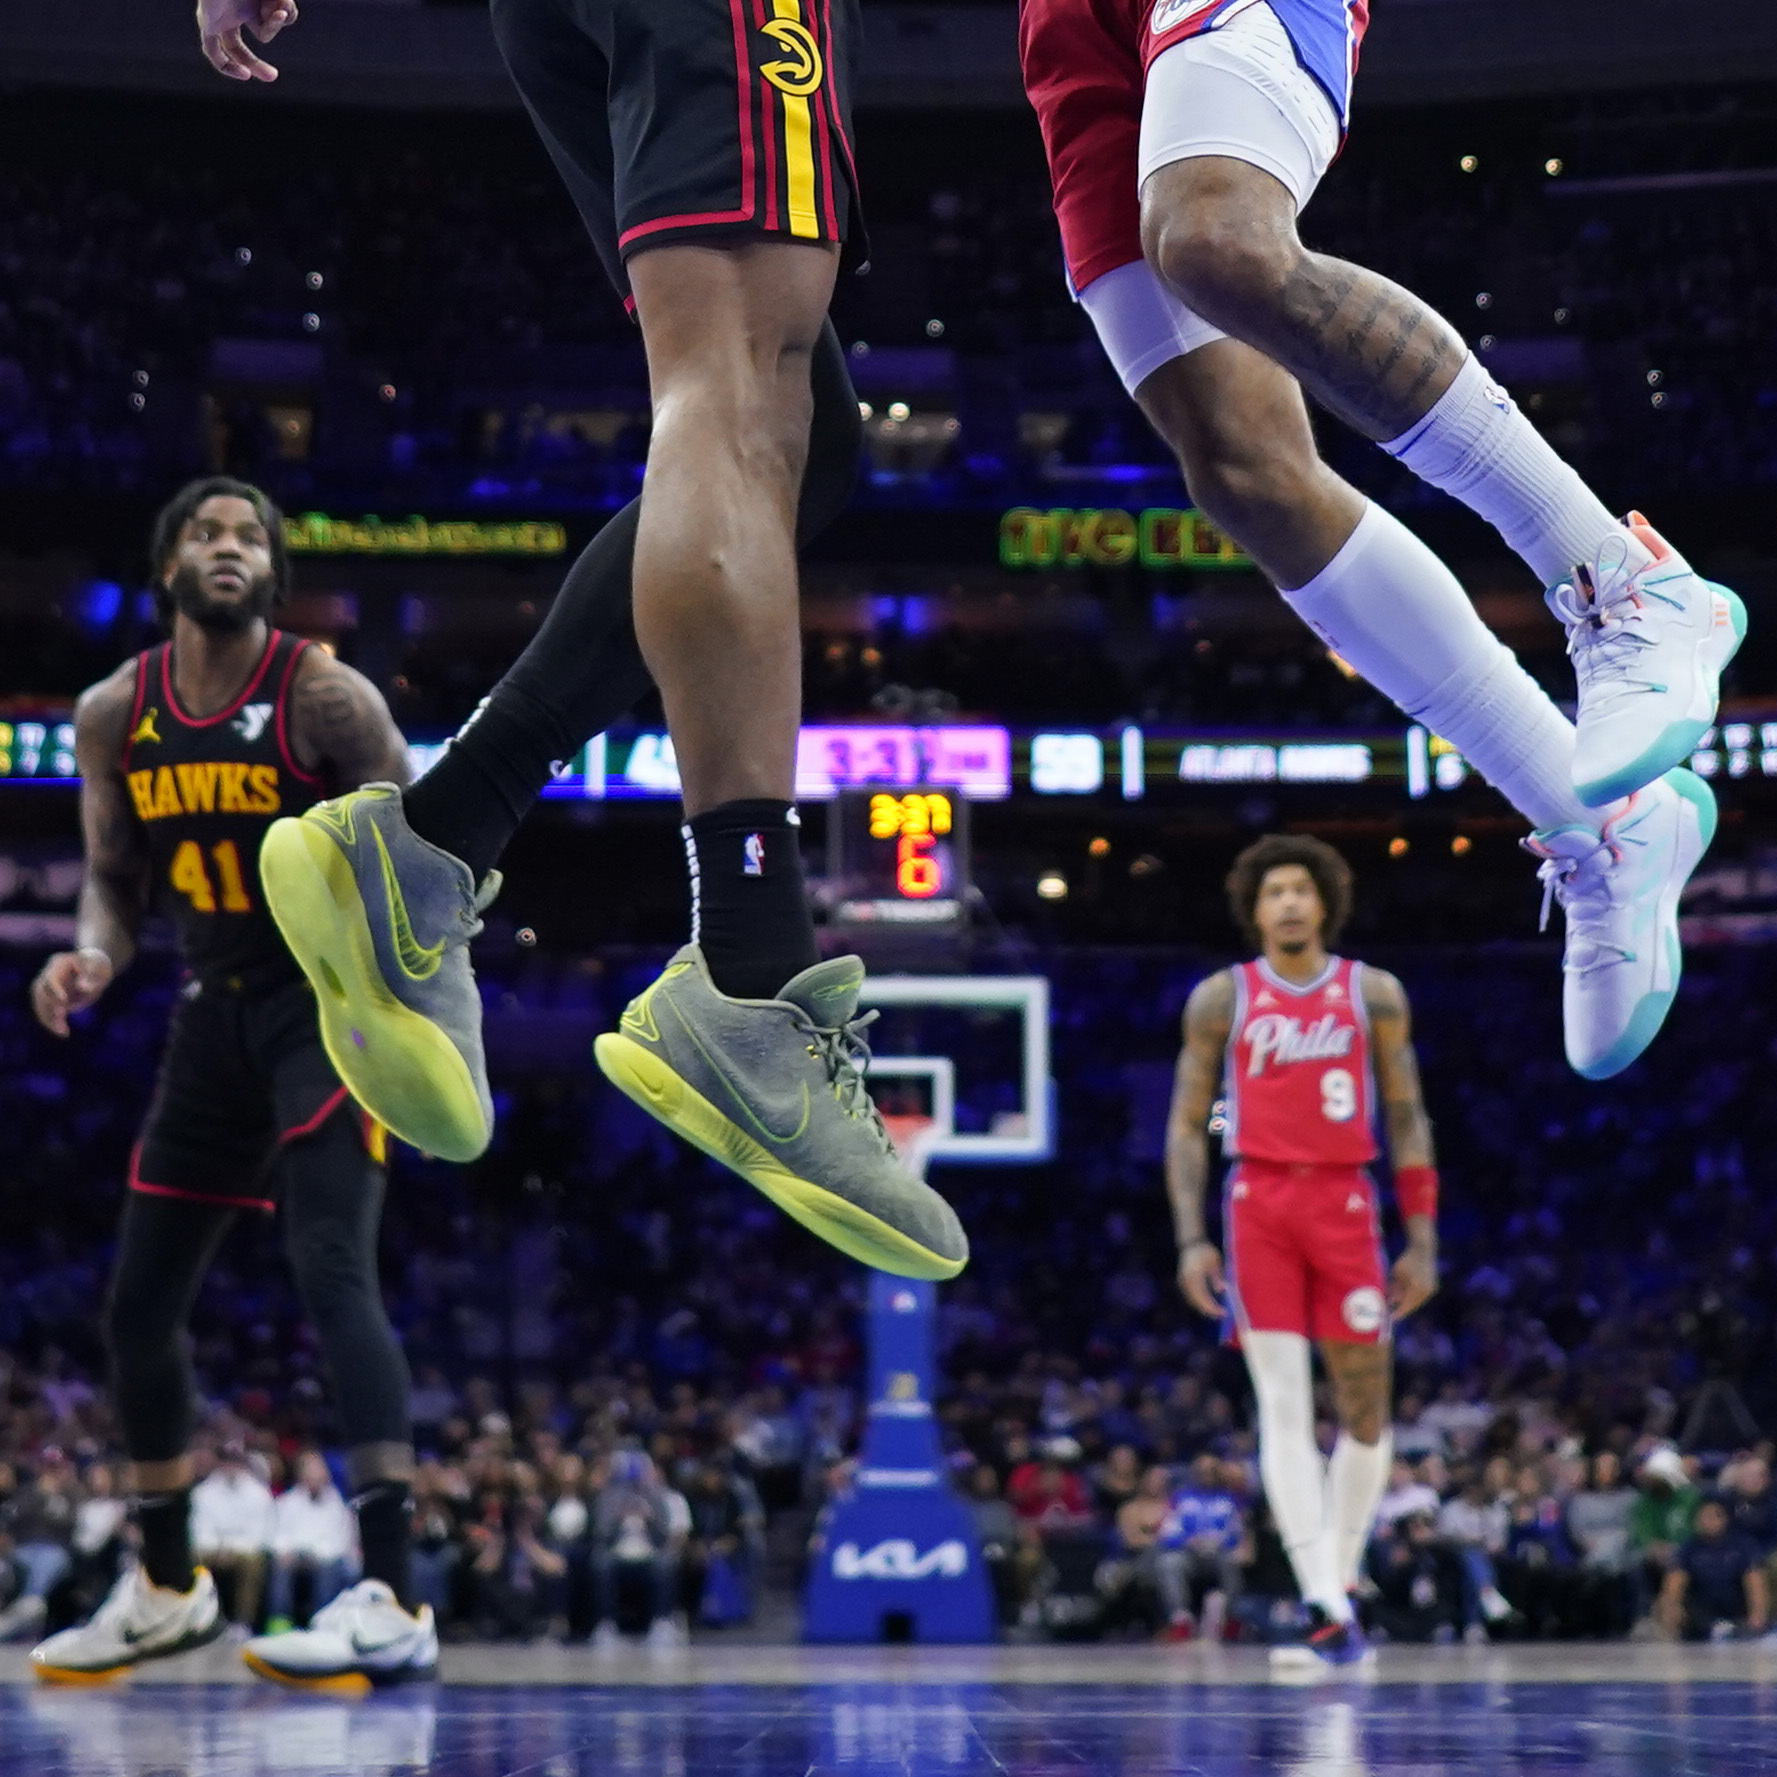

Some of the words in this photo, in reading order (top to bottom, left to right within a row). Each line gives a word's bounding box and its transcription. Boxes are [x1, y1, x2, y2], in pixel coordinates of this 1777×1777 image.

[127, 761, 282, 822] HAWKS
[170, 839, 253, 913] 41
[897, 832, 941, 898] 6
[1243, 1013, 1356, 1080] Phila
[1320, 1068, 1356, 1122] 9
